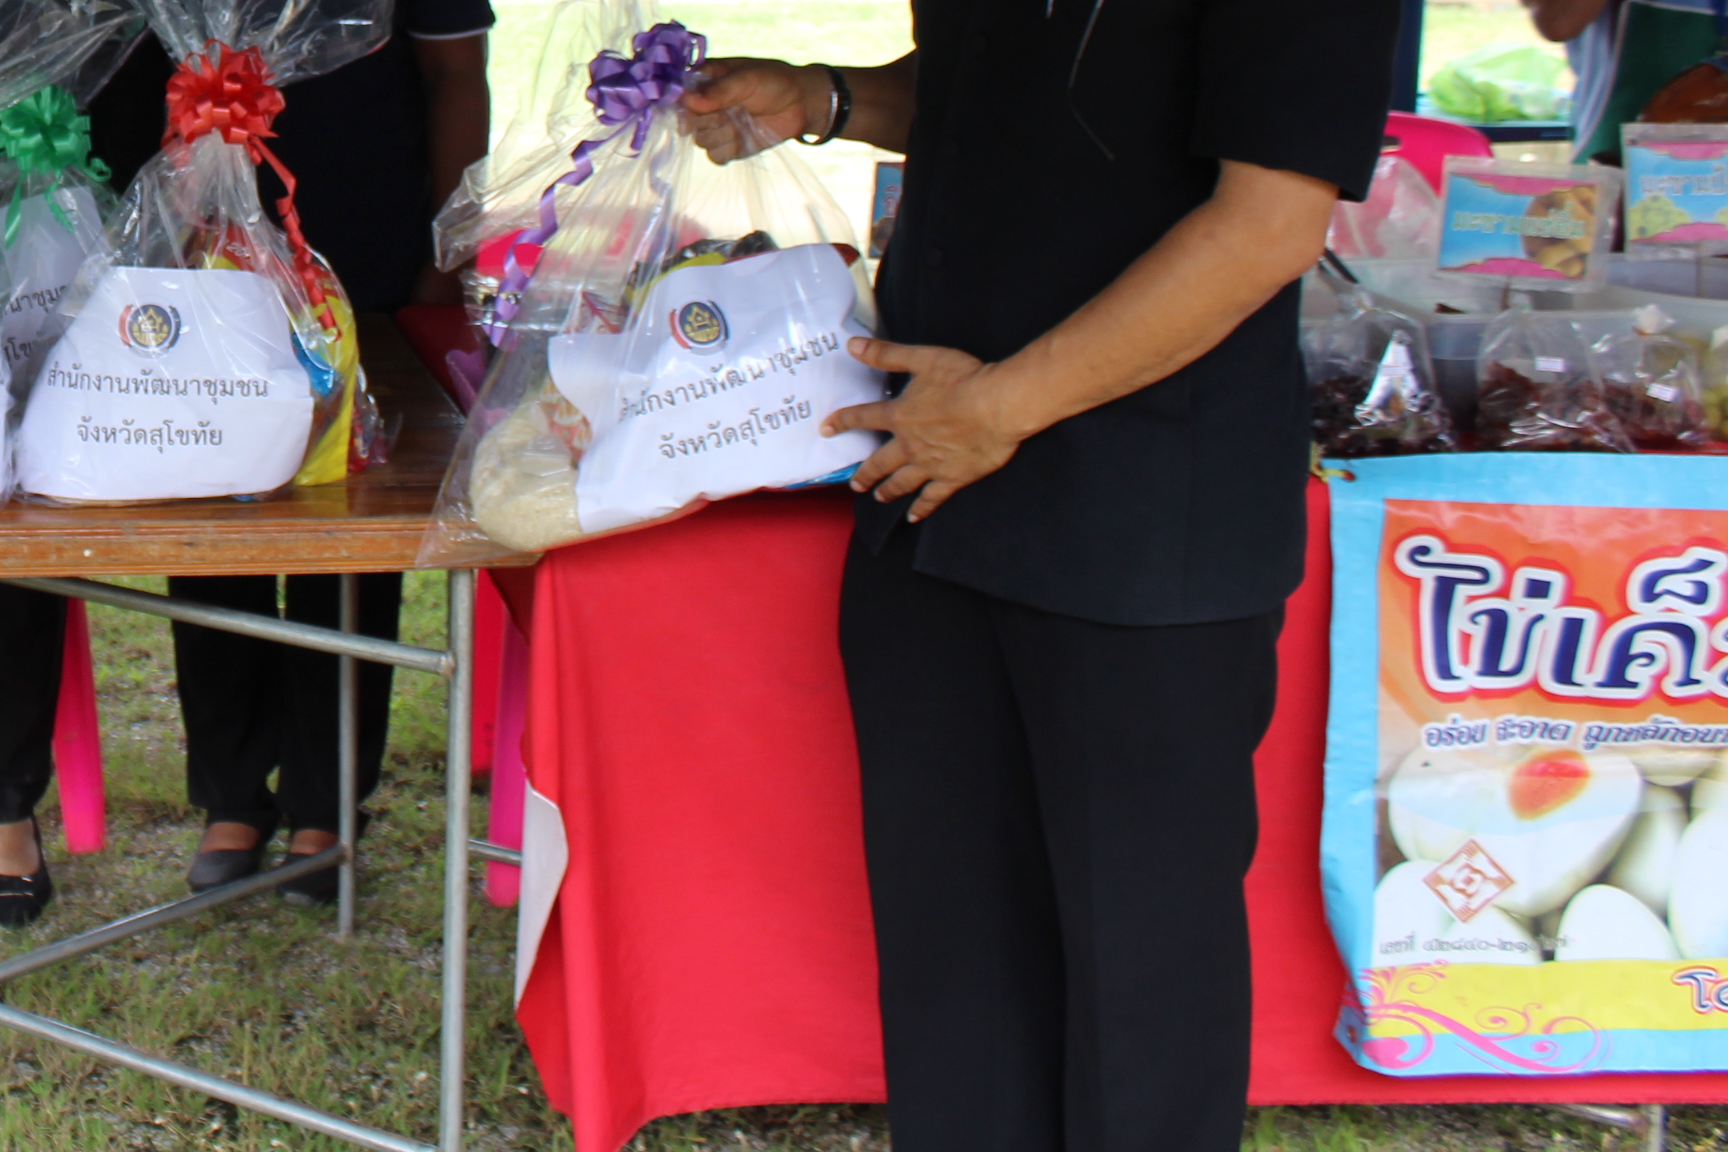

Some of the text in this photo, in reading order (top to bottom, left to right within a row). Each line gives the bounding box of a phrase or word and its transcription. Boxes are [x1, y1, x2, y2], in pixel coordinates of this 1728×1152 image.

[47, 361, 269, 405] สำนักงานพัฒนาชุมชน
[76, 415, 223, 454] จังหวัดสุโขทัย
[658, 394, 812, 459] จังหวัดสุโขทัย
[1400, 540, 1728, 694] ไข่เค็
[1426, 717, 1489, 747] อร่อย
[1495, 718, 1572, 742] สะอาด
